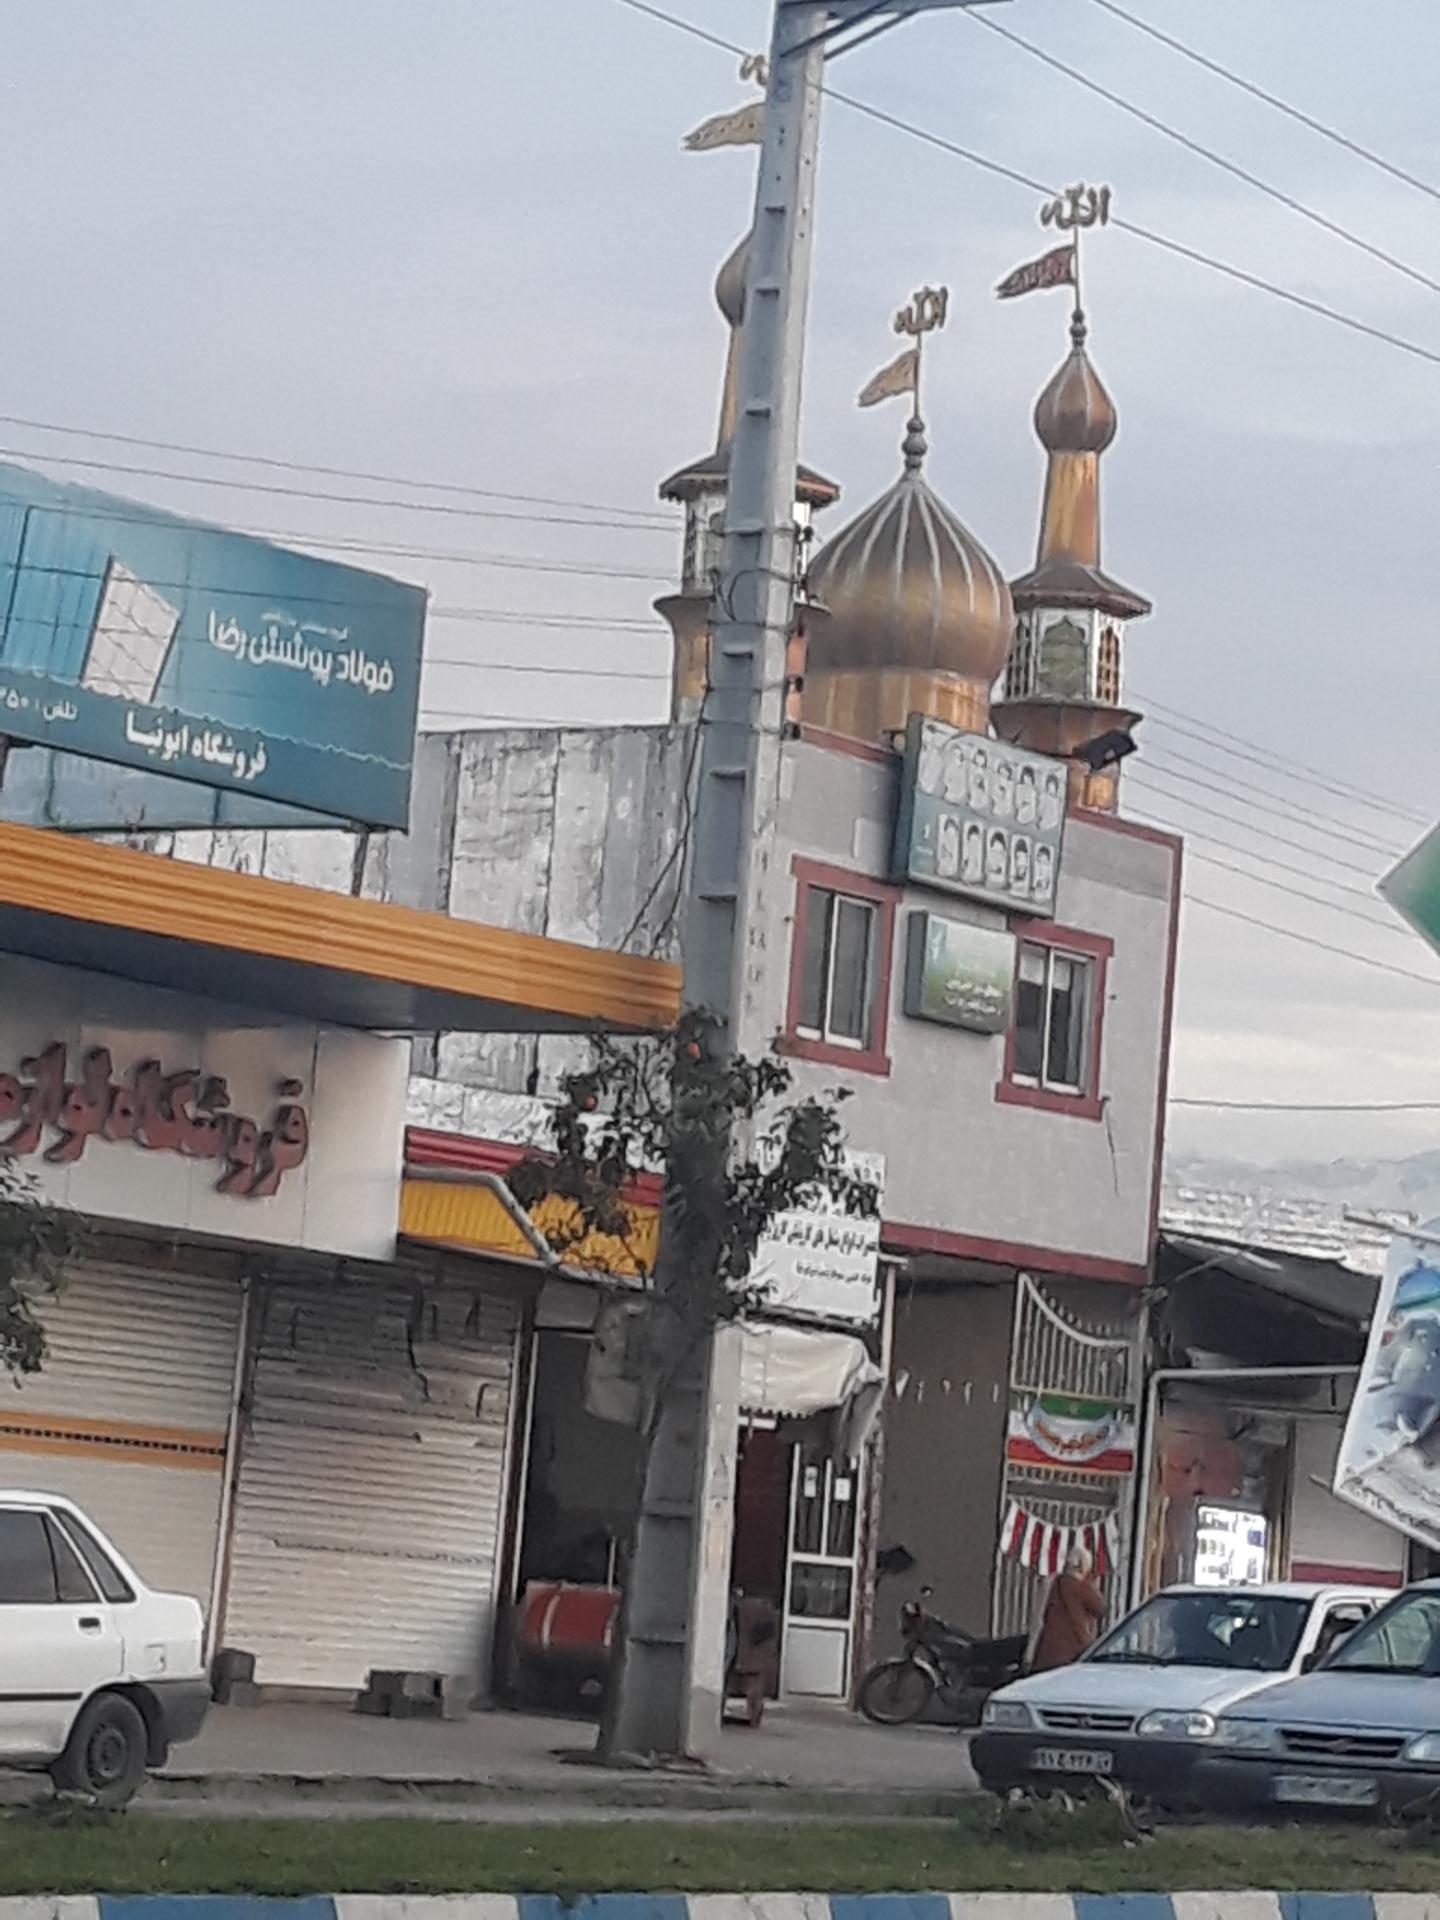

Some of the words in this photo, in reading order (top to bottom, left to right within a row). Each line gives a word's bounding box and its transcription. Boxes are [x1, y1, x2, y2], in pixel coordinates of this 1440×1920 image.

[207, 610, 247, 660] رضا
[336, 651, 394, 695] فولاد
[191, 730, 268, 779] فروشگاه
[103, 1058, 309, 1198] فروشگاه
